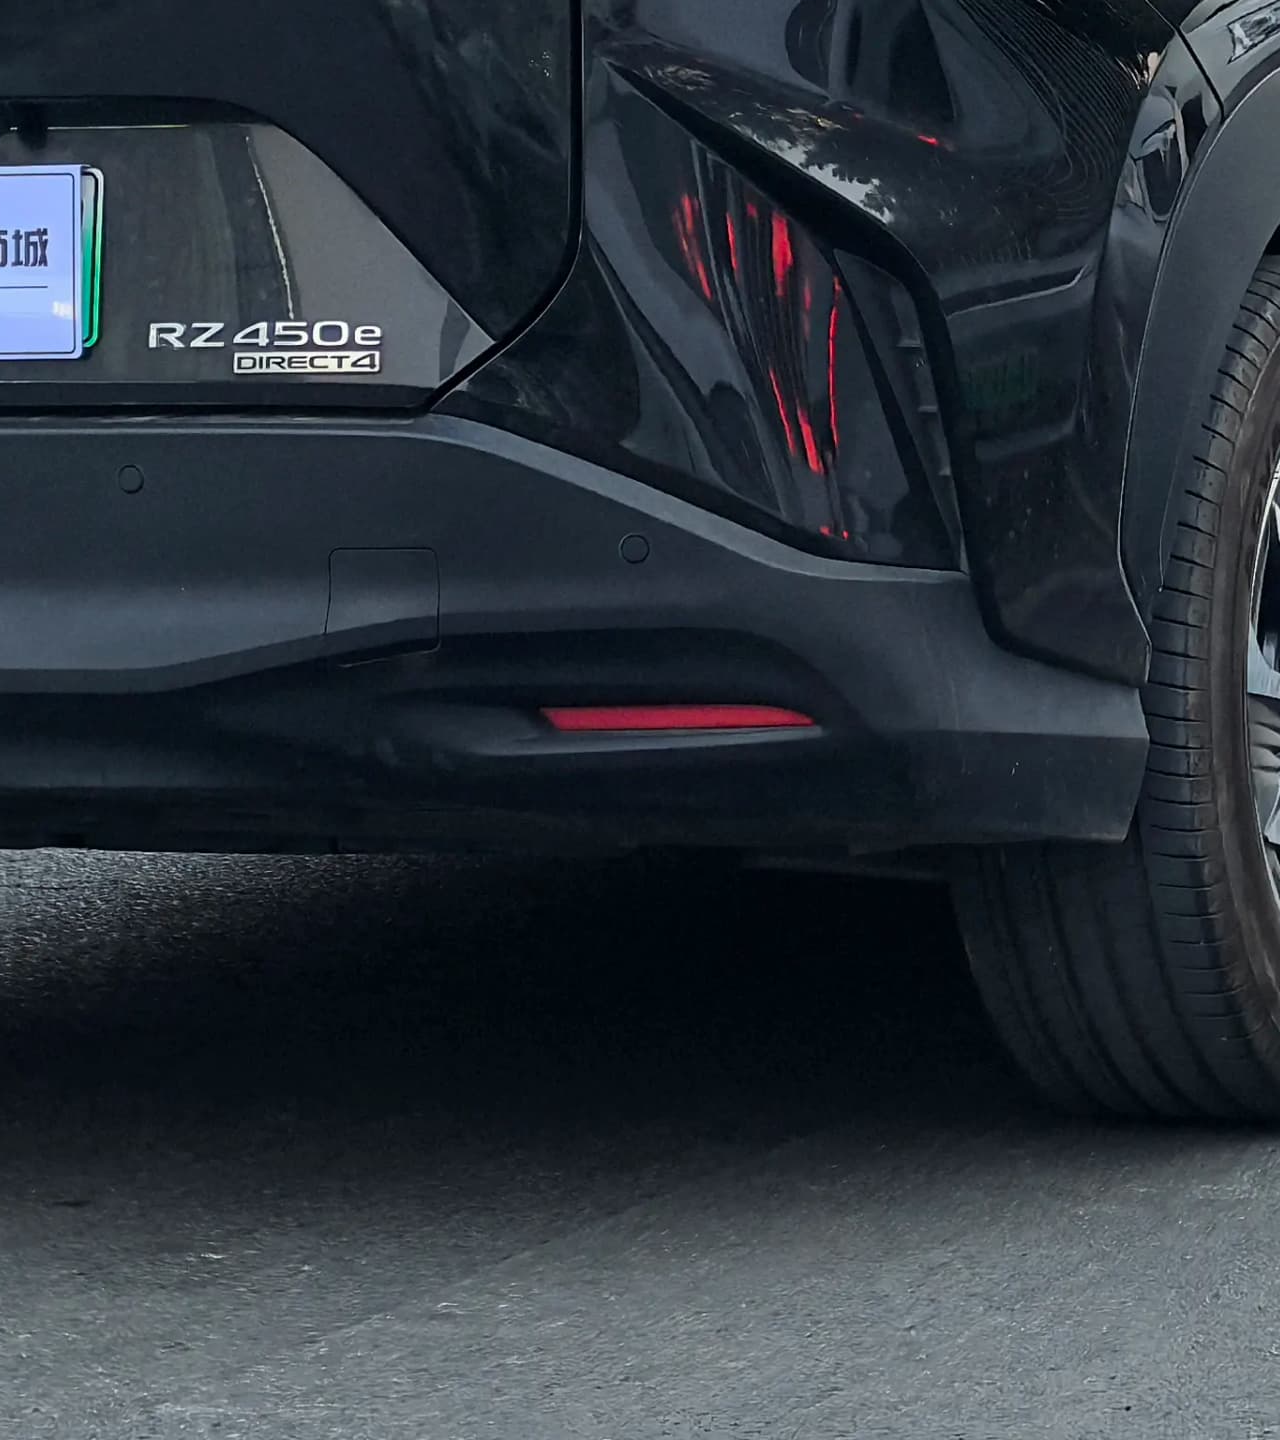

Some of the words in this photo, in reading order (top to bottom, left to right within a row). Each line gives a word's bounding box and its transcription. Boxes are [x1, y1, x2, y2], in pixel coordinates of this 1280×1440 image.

[148, 321, 226, 350] RZ
[232, 320, 382, 348] 450e
[236, 353, 377, 371] DIRECT4
